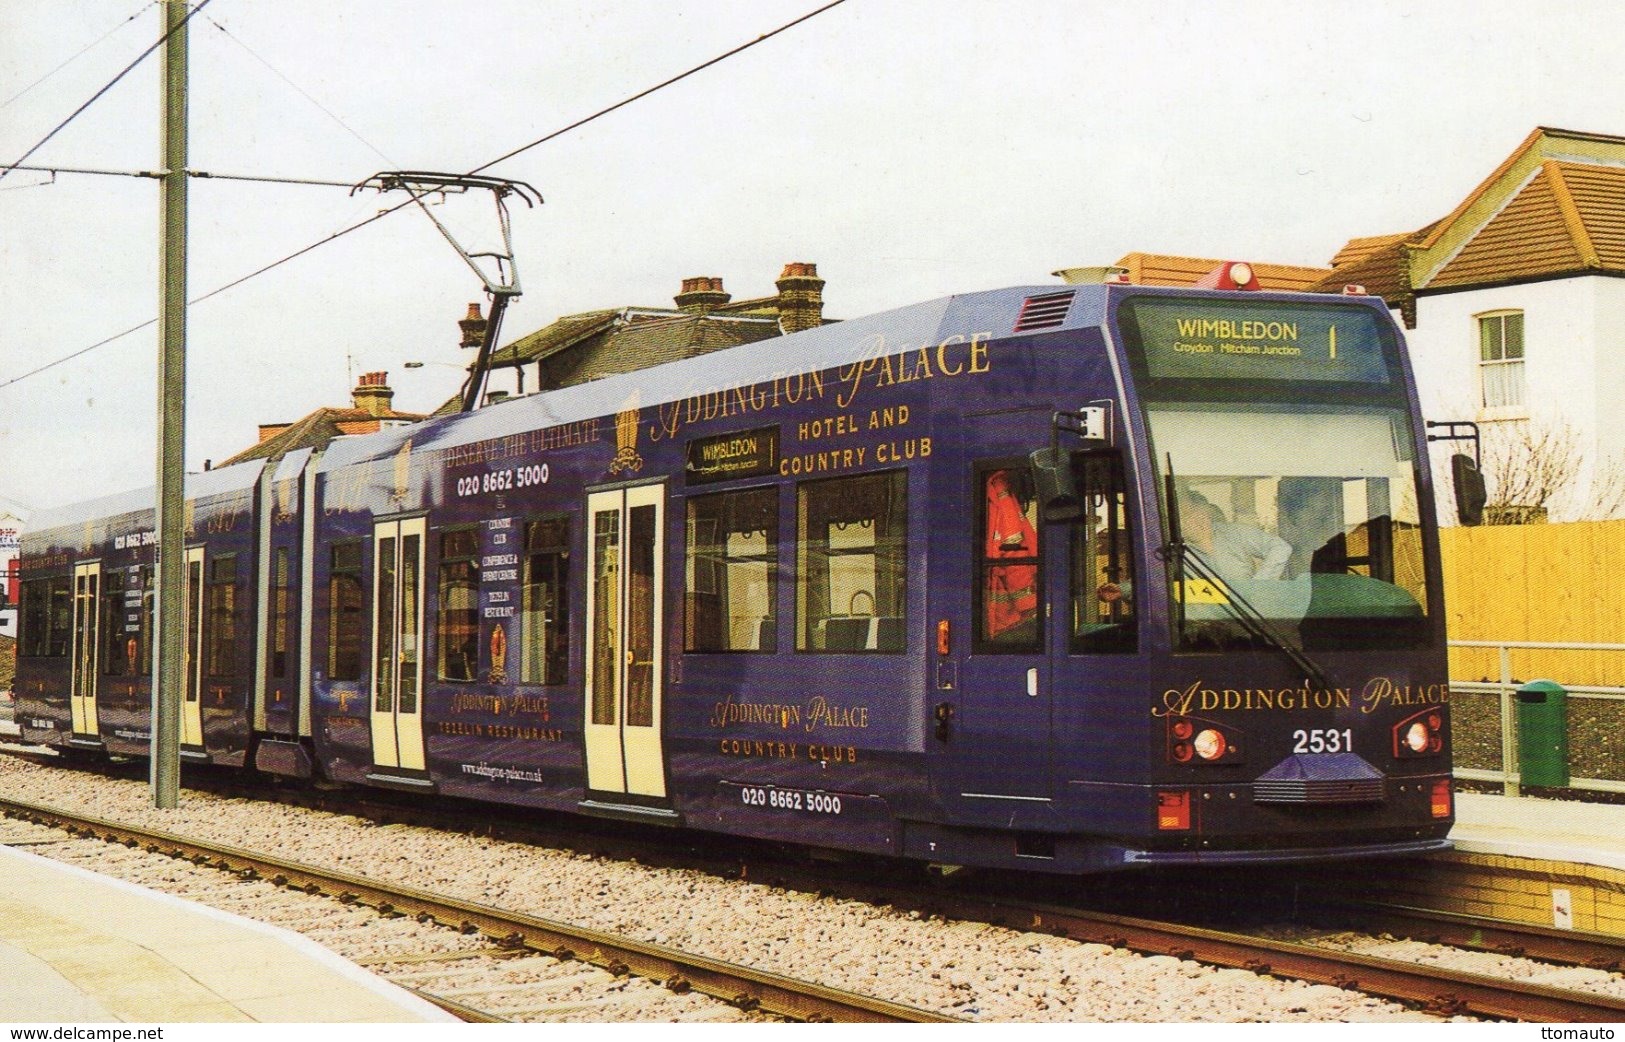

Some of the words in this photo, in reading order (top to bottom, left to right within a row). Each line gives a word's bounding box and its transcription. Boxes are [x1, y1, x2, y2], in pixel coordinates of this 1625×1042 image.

[1176, 318, 1298, 341] WIMBLEDON
[1173, 341, 1214, 355] Croydon
[1220, 343, 1261, 355] Mitcham
[1262, 345, 1301, 356] Junction
[650, 360, 825, 442] ADDINGTON
[836, 330, 993, 408] PALACE
[502, 434, 528, 458] THE
[531, 418, 601, 453] ULTIMATE
[798, 414, 859, 441] HOTEL
[867, 404, 910, 430] AND
[702, 437, 757, 461] WIMBLEDON
[779, 446, 867, 477] COUNTRY
[876, 436, 933, 463] CLUB
[457, 475, 480, 497] 020
[482, 469, 513, 494] 8662
[516, 462, 550, 489] 5000
[1152, 680, 1351, 717] ADDINGTON
[1361, 676, 1449, 714] PALACE
[710, 694, 800, 730] ADDINGTON
[805, 695, 868, 733] PALACE
[487, 724, 563, 742] RESTAURANT
[1292, 728, 1353, 754] 2531
[720, 739, 797, 760] COUNTRY
[808, 744, 857, 763] CLUB
[741, 787, 766, 806] 020
[769, 789, 802, 810] 8662
[806, 793, 842, 815] 5000
